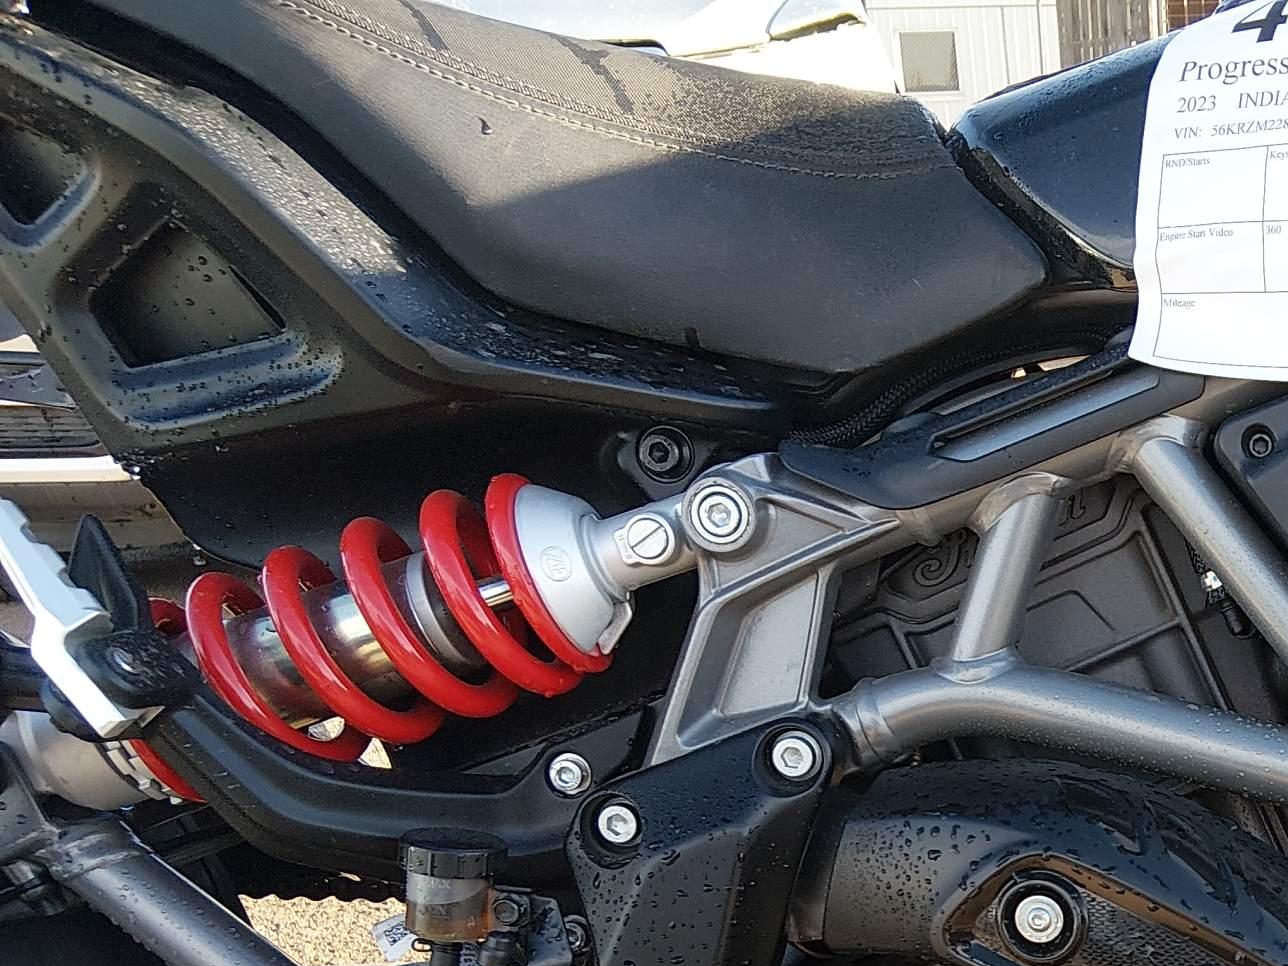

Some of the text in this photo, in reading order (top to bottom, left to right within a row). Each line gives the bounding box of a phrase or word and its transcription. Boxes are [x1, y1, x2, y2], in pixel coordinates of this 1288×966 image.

[1176, 96, 1217, 113] 2023
[1175, 127, 1202, 139] VIN:
[1208, 227, 1234, 237] Video
[1265, 225, 1282, 235] 360
[1164, 298, 1196, 308] Mileage
